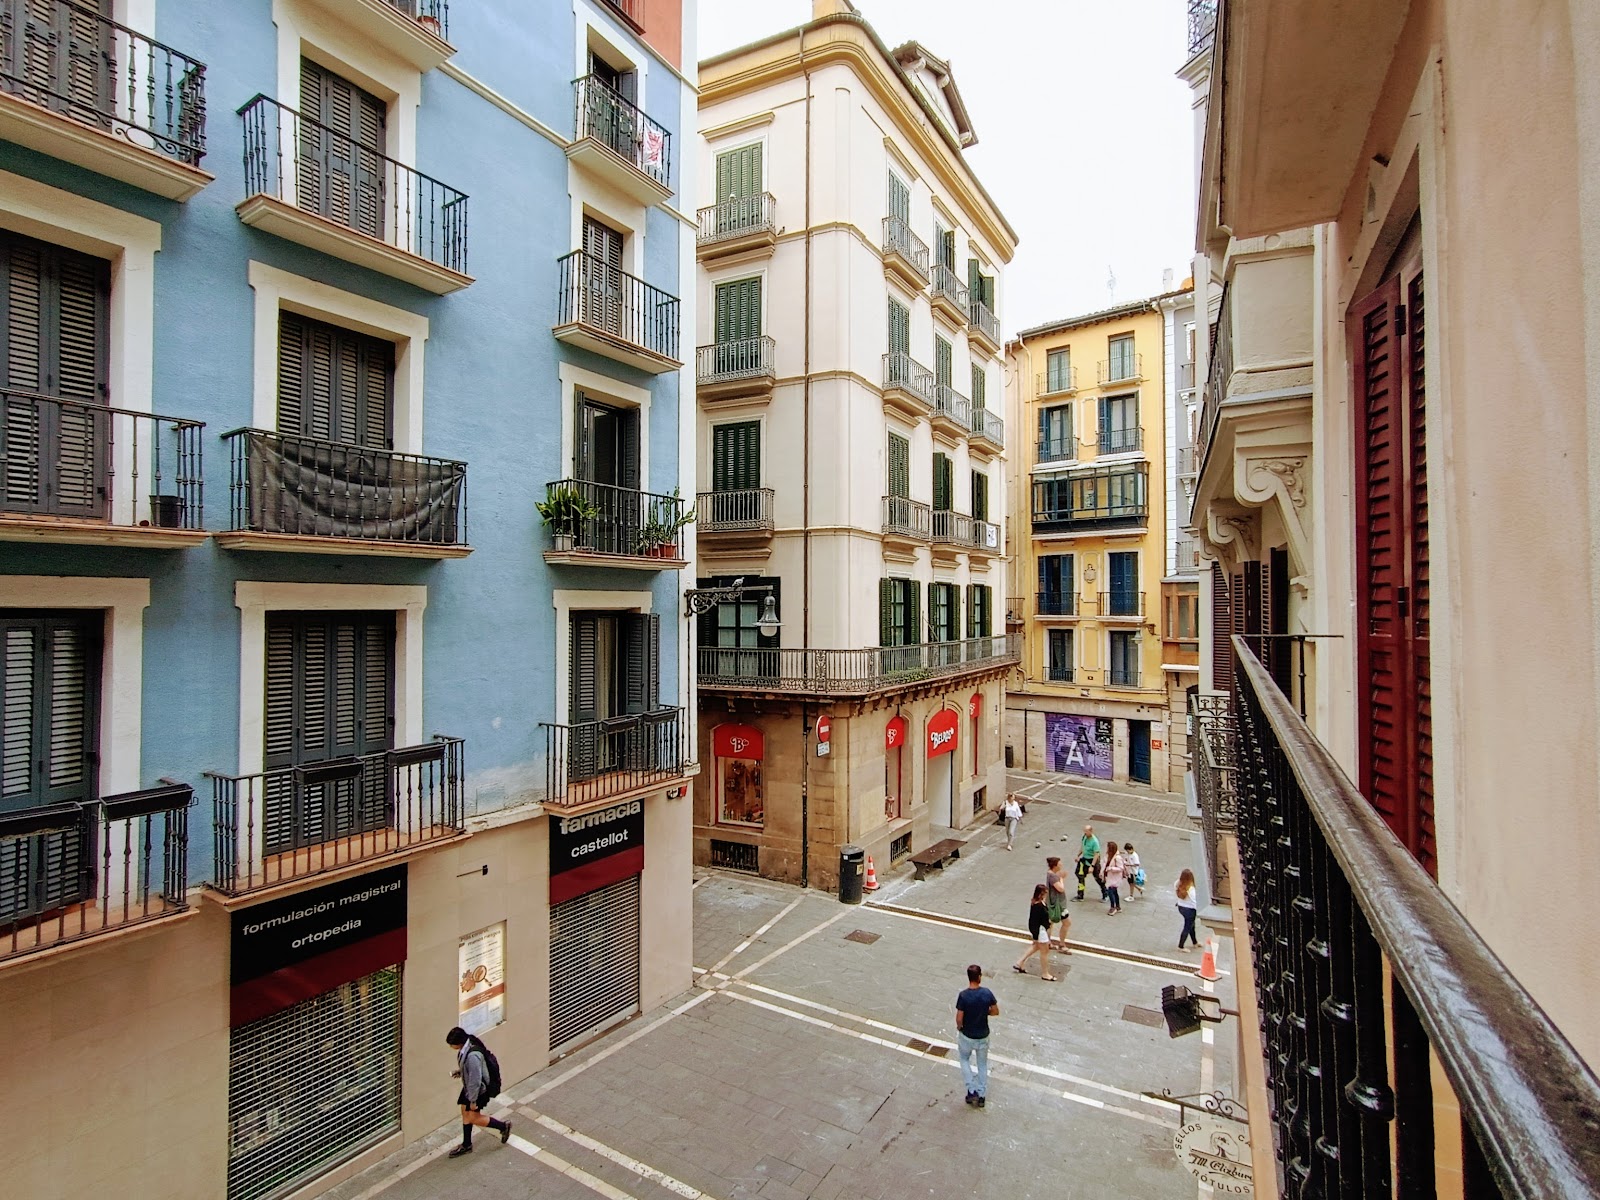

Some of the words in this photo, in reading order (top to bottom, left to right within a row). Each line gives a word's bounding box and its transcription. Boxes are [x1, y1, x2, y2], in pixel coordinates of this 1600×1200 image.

[560, 800, 641, 835] farmacia
[571, 829, 629, 858] castellot
[242, 902, 335, 936] formulación
[339, 880, 401, 907] magistral
[291, 919, 362, 949] ortopedia
[1174, 1123, 1202, 1150] SELLOS
[1192, 1169, 1251, 1194] RÓTULOS
